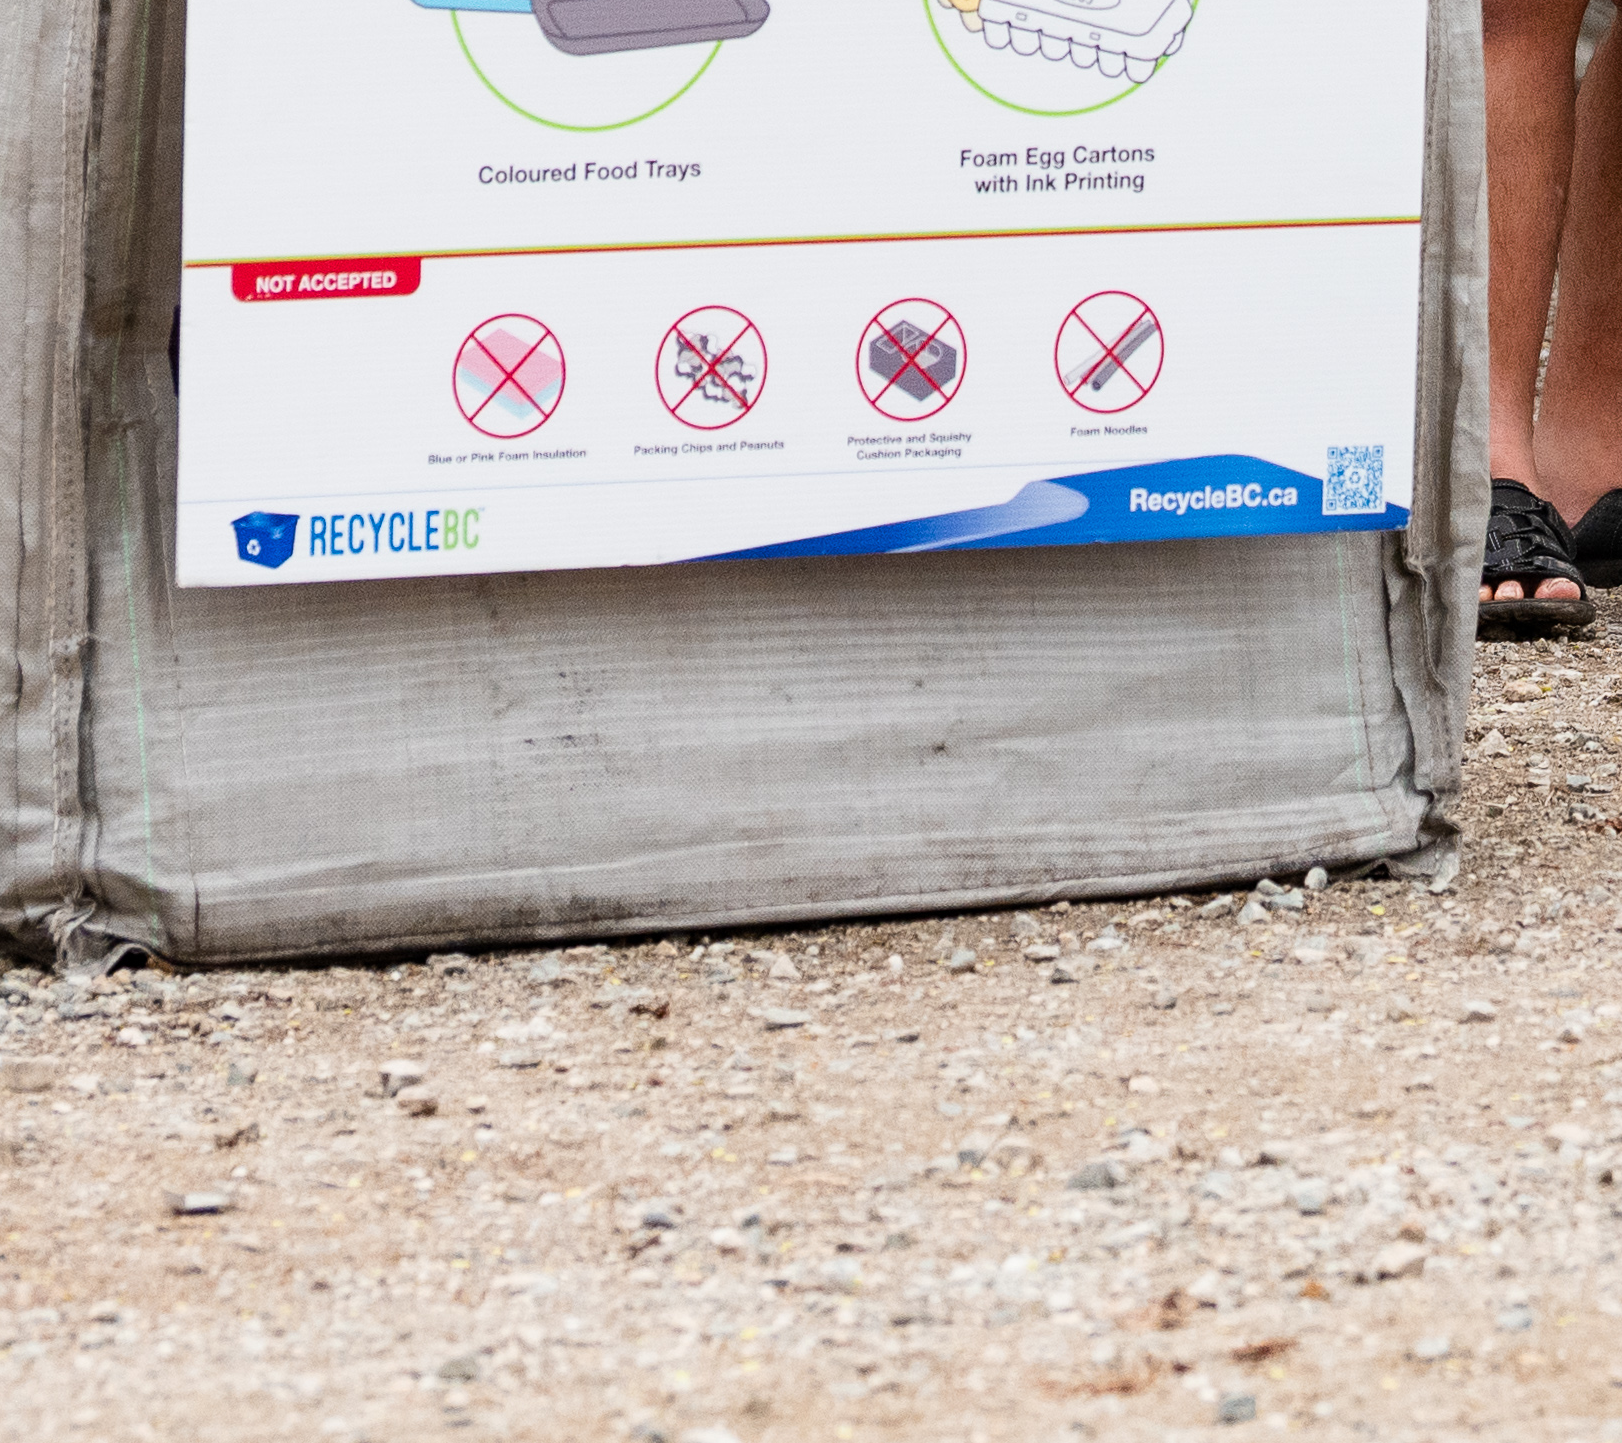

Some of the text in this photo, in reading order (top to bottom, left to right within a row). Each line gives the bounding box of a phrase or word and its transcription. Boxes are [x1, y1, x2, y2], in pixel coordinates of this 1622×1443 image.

[958, 143, 1156, 172] Foam Egg Cartons
[477, 158, 702, 186] Coloured Food Trays
[974, 169, 1145, 195] with Ink Printing
[254, 269, 398, 295] NOT ACCEPTED
[847, 432, 972, 447] Protective and Squishy
[1071, 425, 1148, 437] Foam Noodles
[428, 449, 587, 465] Blue or Pink Foam Insulation
[633, 440, 785, 456] Packing Chips and Peanuts
[856, 447, 962, 461] Cushion Packaging
[1128, 483, 1298, 514] RecycleBC.ca
[309, 509, 483, 557] RECYCLEBC
